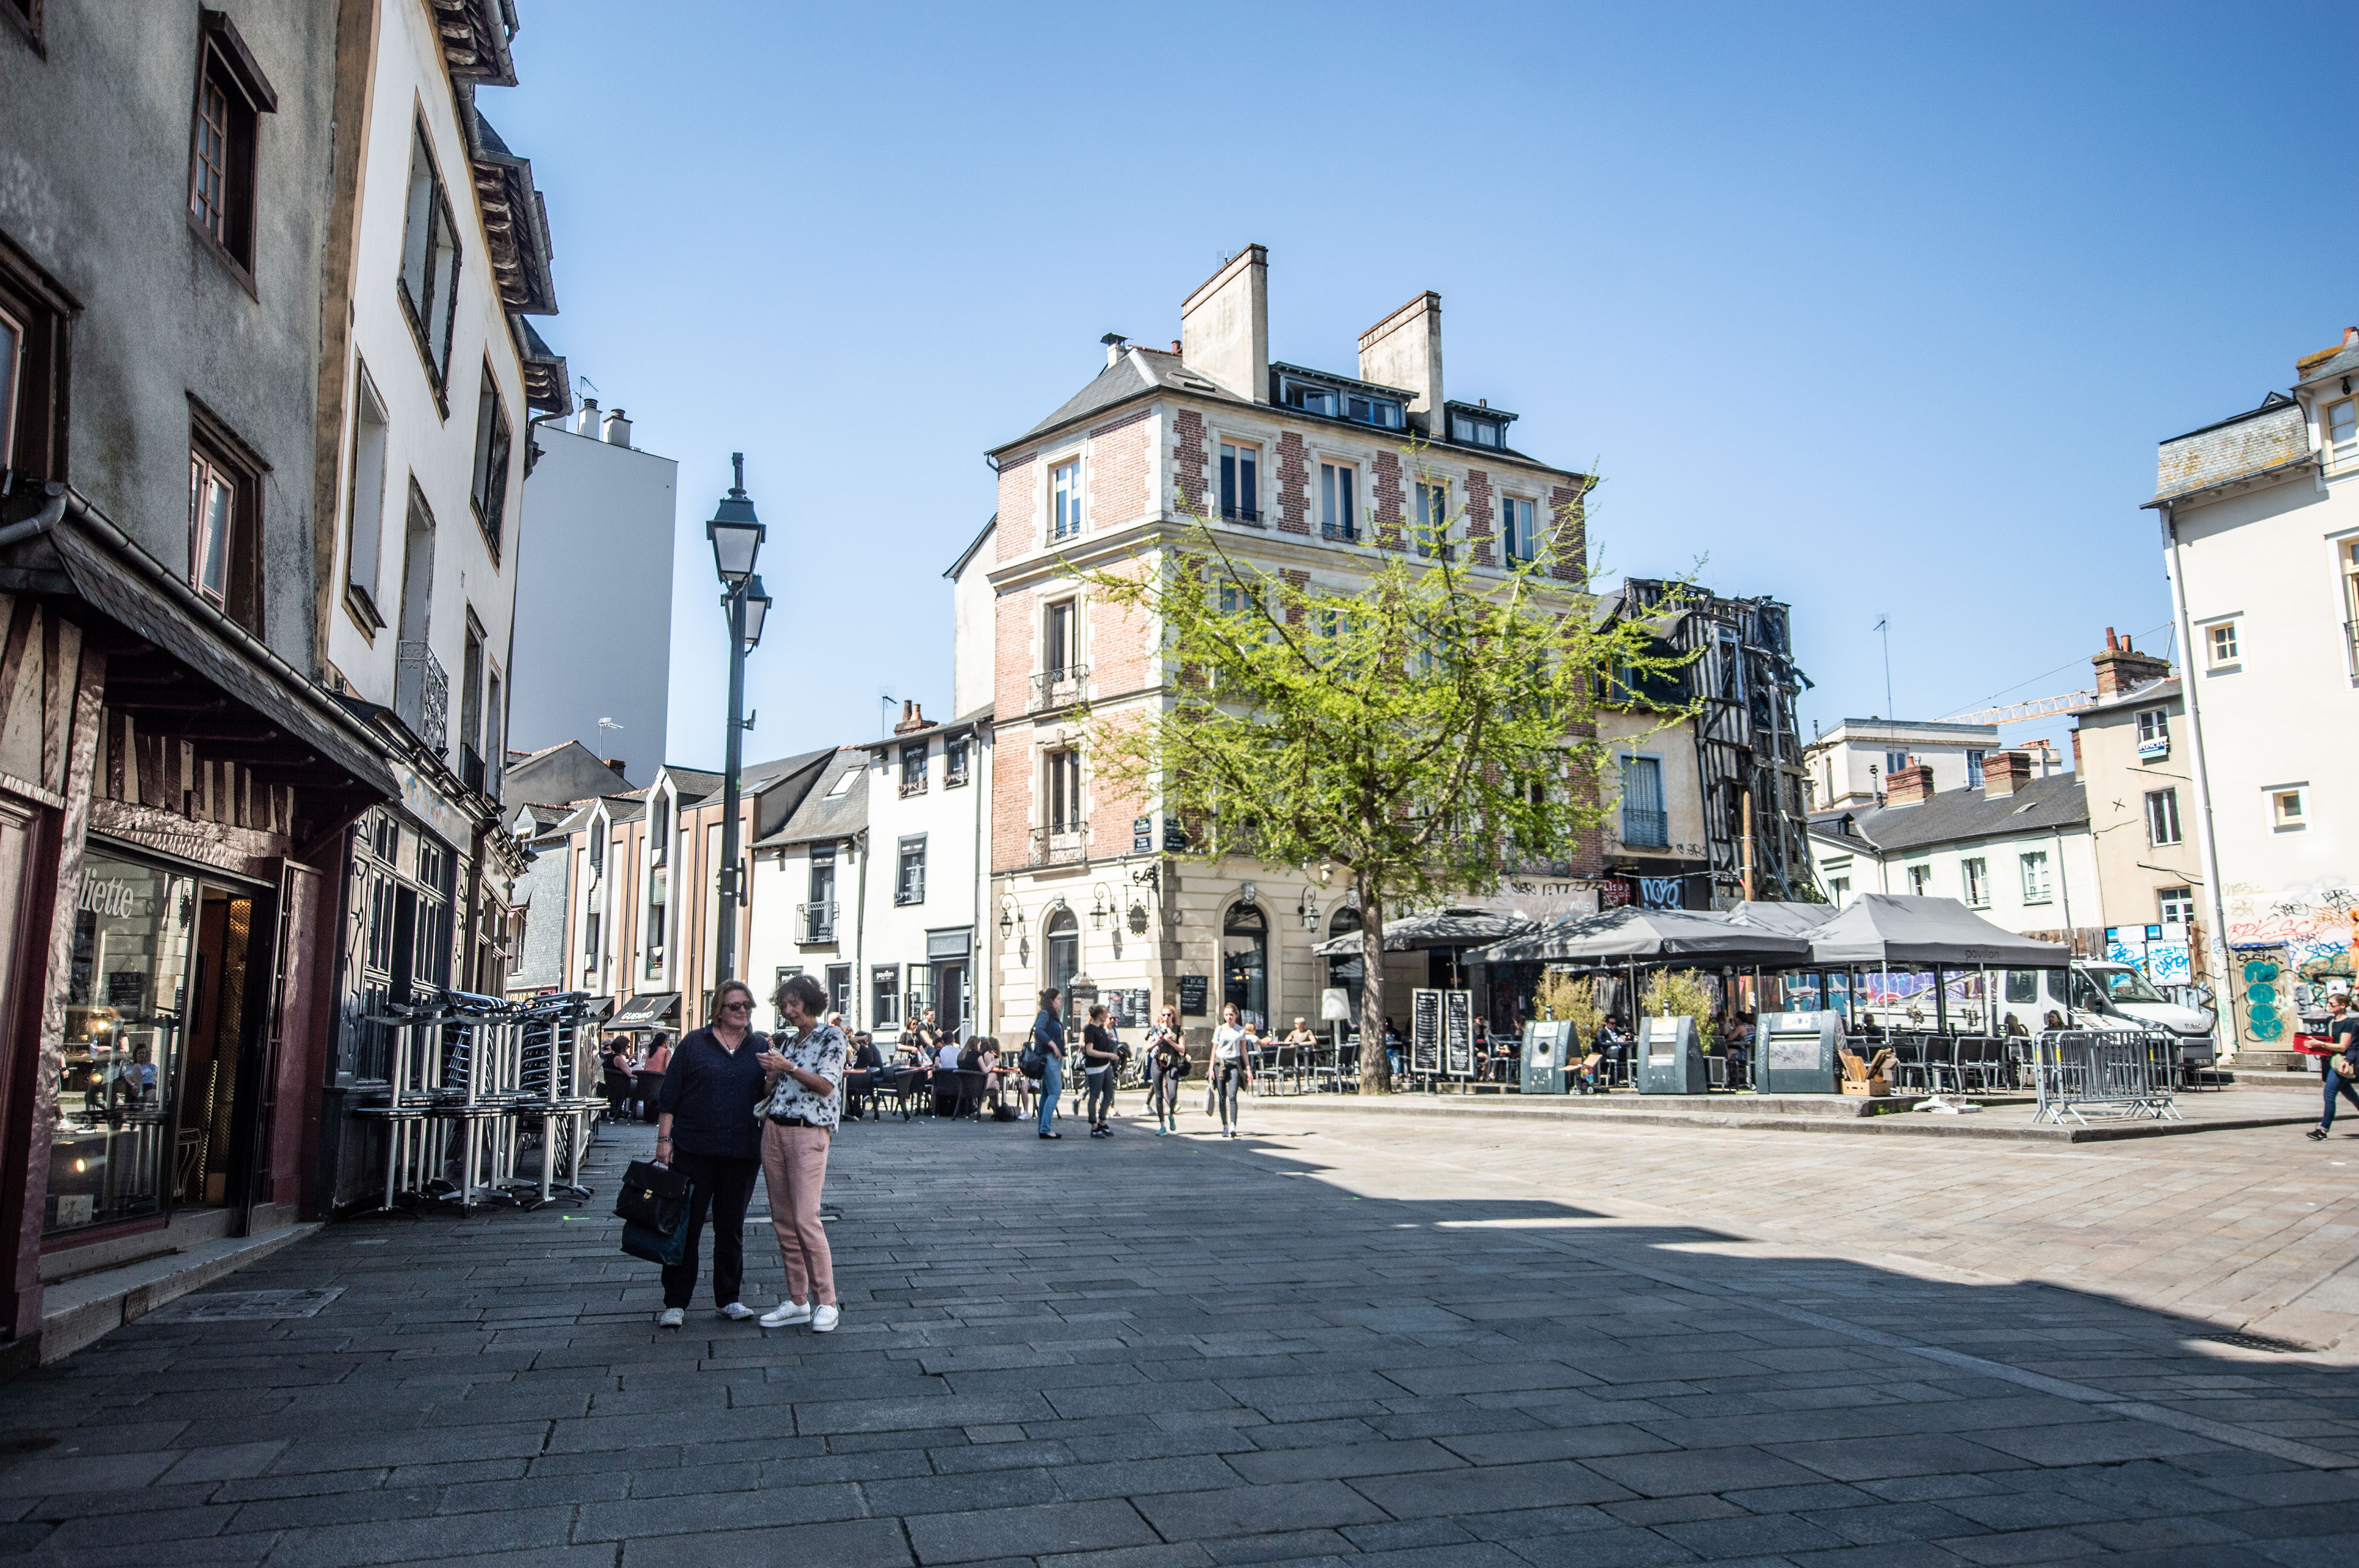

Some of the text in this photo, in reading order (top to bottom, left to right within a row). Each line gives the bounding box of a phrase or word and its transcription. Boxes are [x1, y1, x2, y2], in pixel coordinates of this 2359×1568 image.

[2139, 742, 2165, 751] FONCIA
[876, 970, 894, 979] pavillon
[621, 1010, 654, 1020] GUENNO
